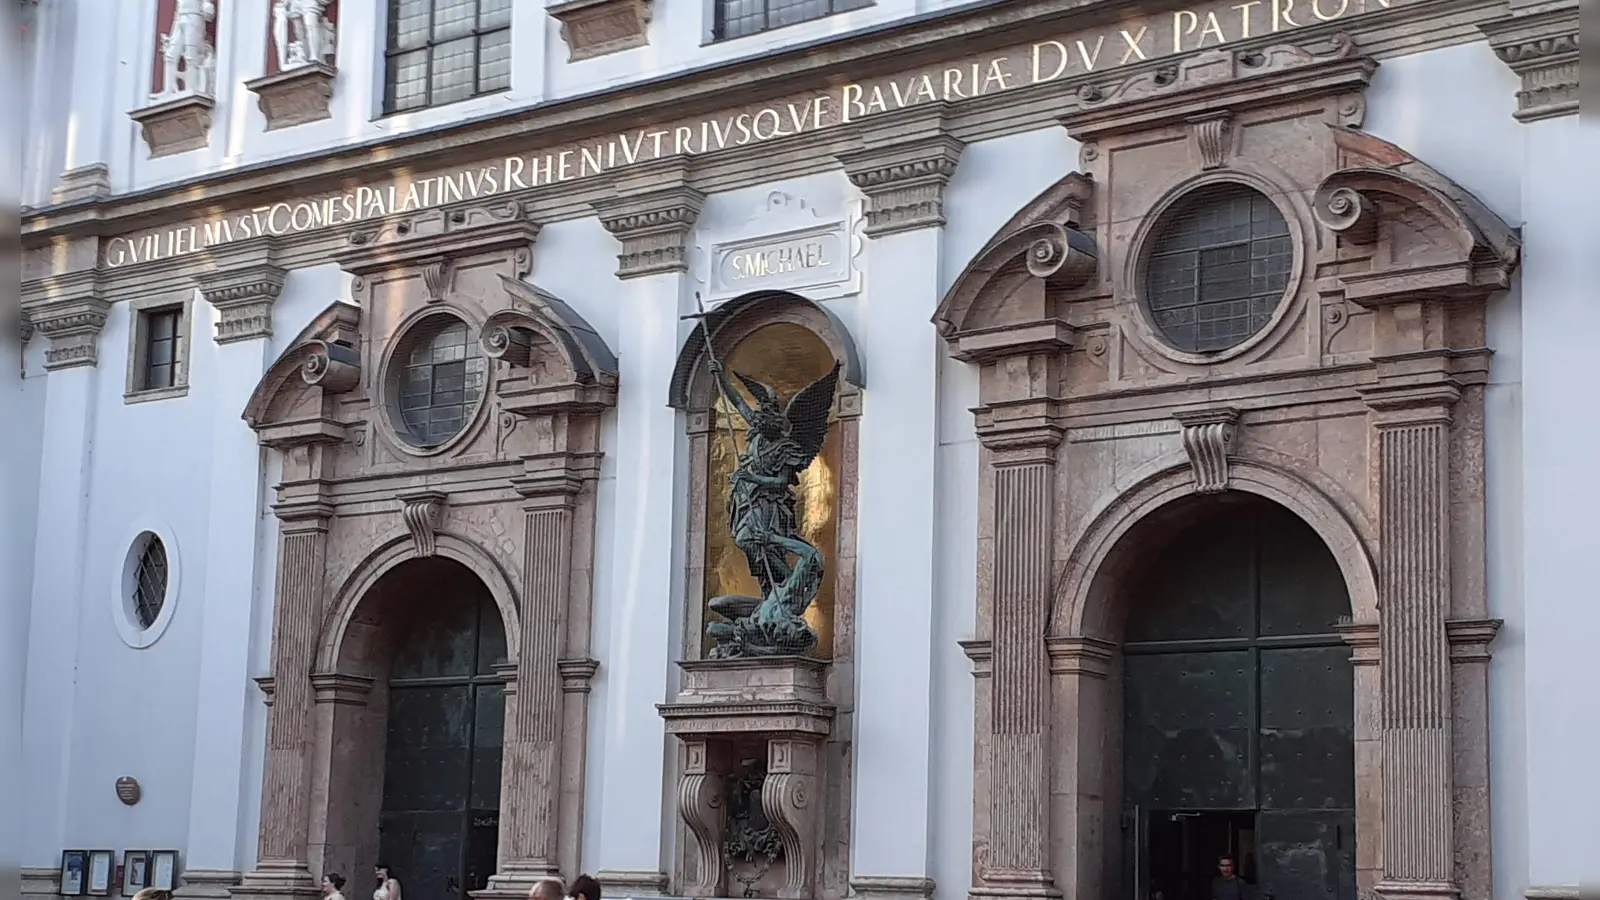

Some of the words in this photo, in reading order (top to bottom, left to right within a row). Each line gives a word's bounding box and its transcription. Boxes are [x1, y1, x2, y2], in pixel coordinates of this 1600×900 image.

[106, 214, 252, 268] GVILIELMVS
[268, 194, 354, 235] COMES
[355, 166, 498, 219] PALATINVS
[505, 142, 615, 191] RHENI
[619, 95, 831, 164] VTRIVSQVE
[1032, 26, 1147, 83] DVX
